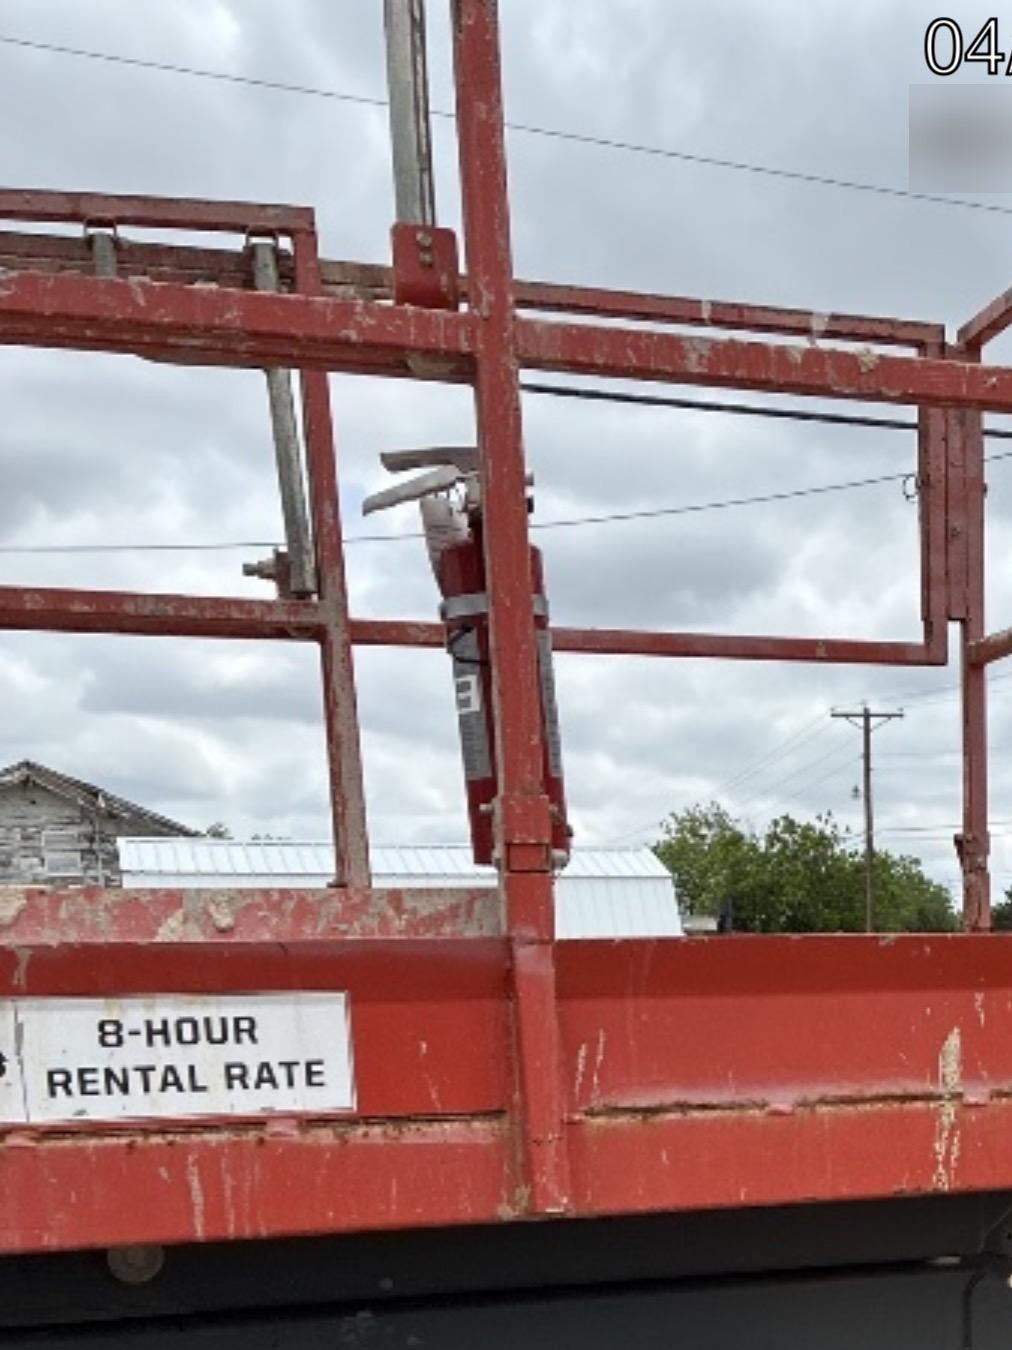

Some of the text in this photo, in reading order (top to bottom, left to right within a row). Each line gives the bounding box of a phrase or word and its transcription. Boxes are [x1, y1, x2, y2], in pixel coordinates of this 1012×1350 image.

[97, 1015, 259, 1049] 8-HOUR
[46, 1058, 326, 1099] RENTAL RATE
